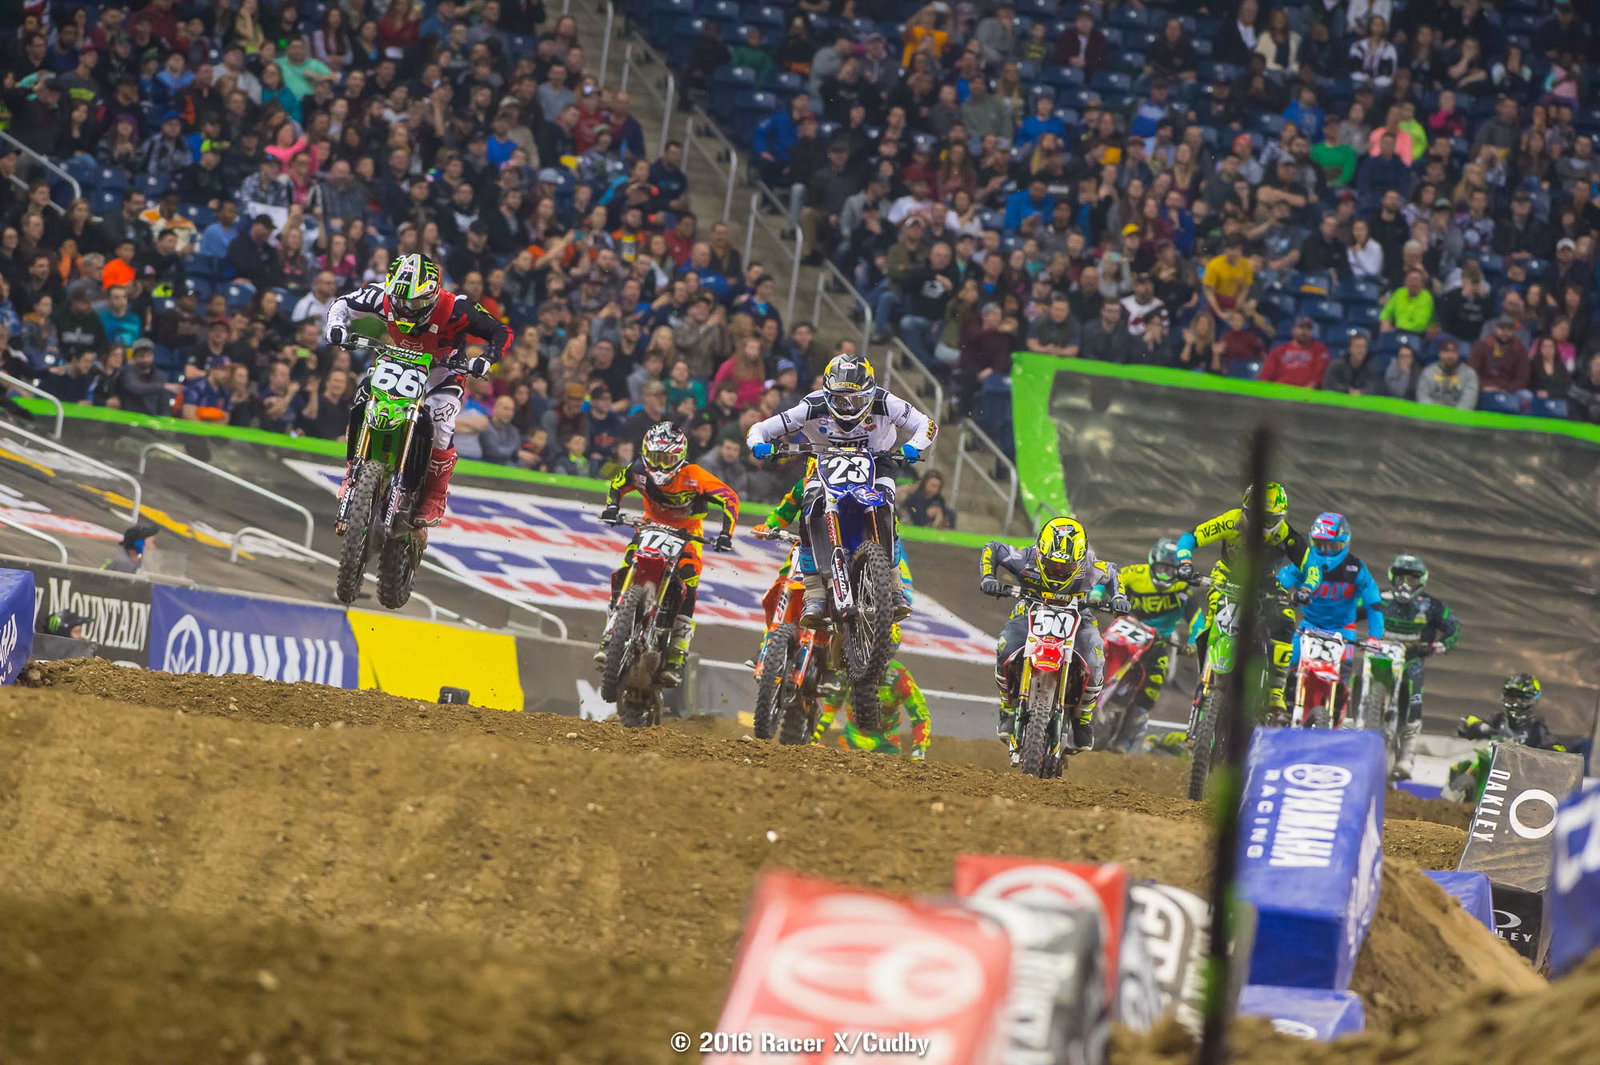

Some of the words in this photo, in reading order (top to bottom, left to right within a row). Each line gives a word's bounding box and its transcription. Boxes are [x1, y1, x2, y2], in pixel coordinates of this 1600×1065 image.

[371, 361, 427, 398] 66
[827, 456, 871, 485] 23
[384, 485, 399, 526] DUNLOP
[639, 530, 686, 557] 175
[1032, 609, 1075, 639] 50
[1246, 769, 1281, 858] RACING
[1472, 769, 1511, 843] OAKLEY
[1269, 788, 1345, 867] YAMAHA
